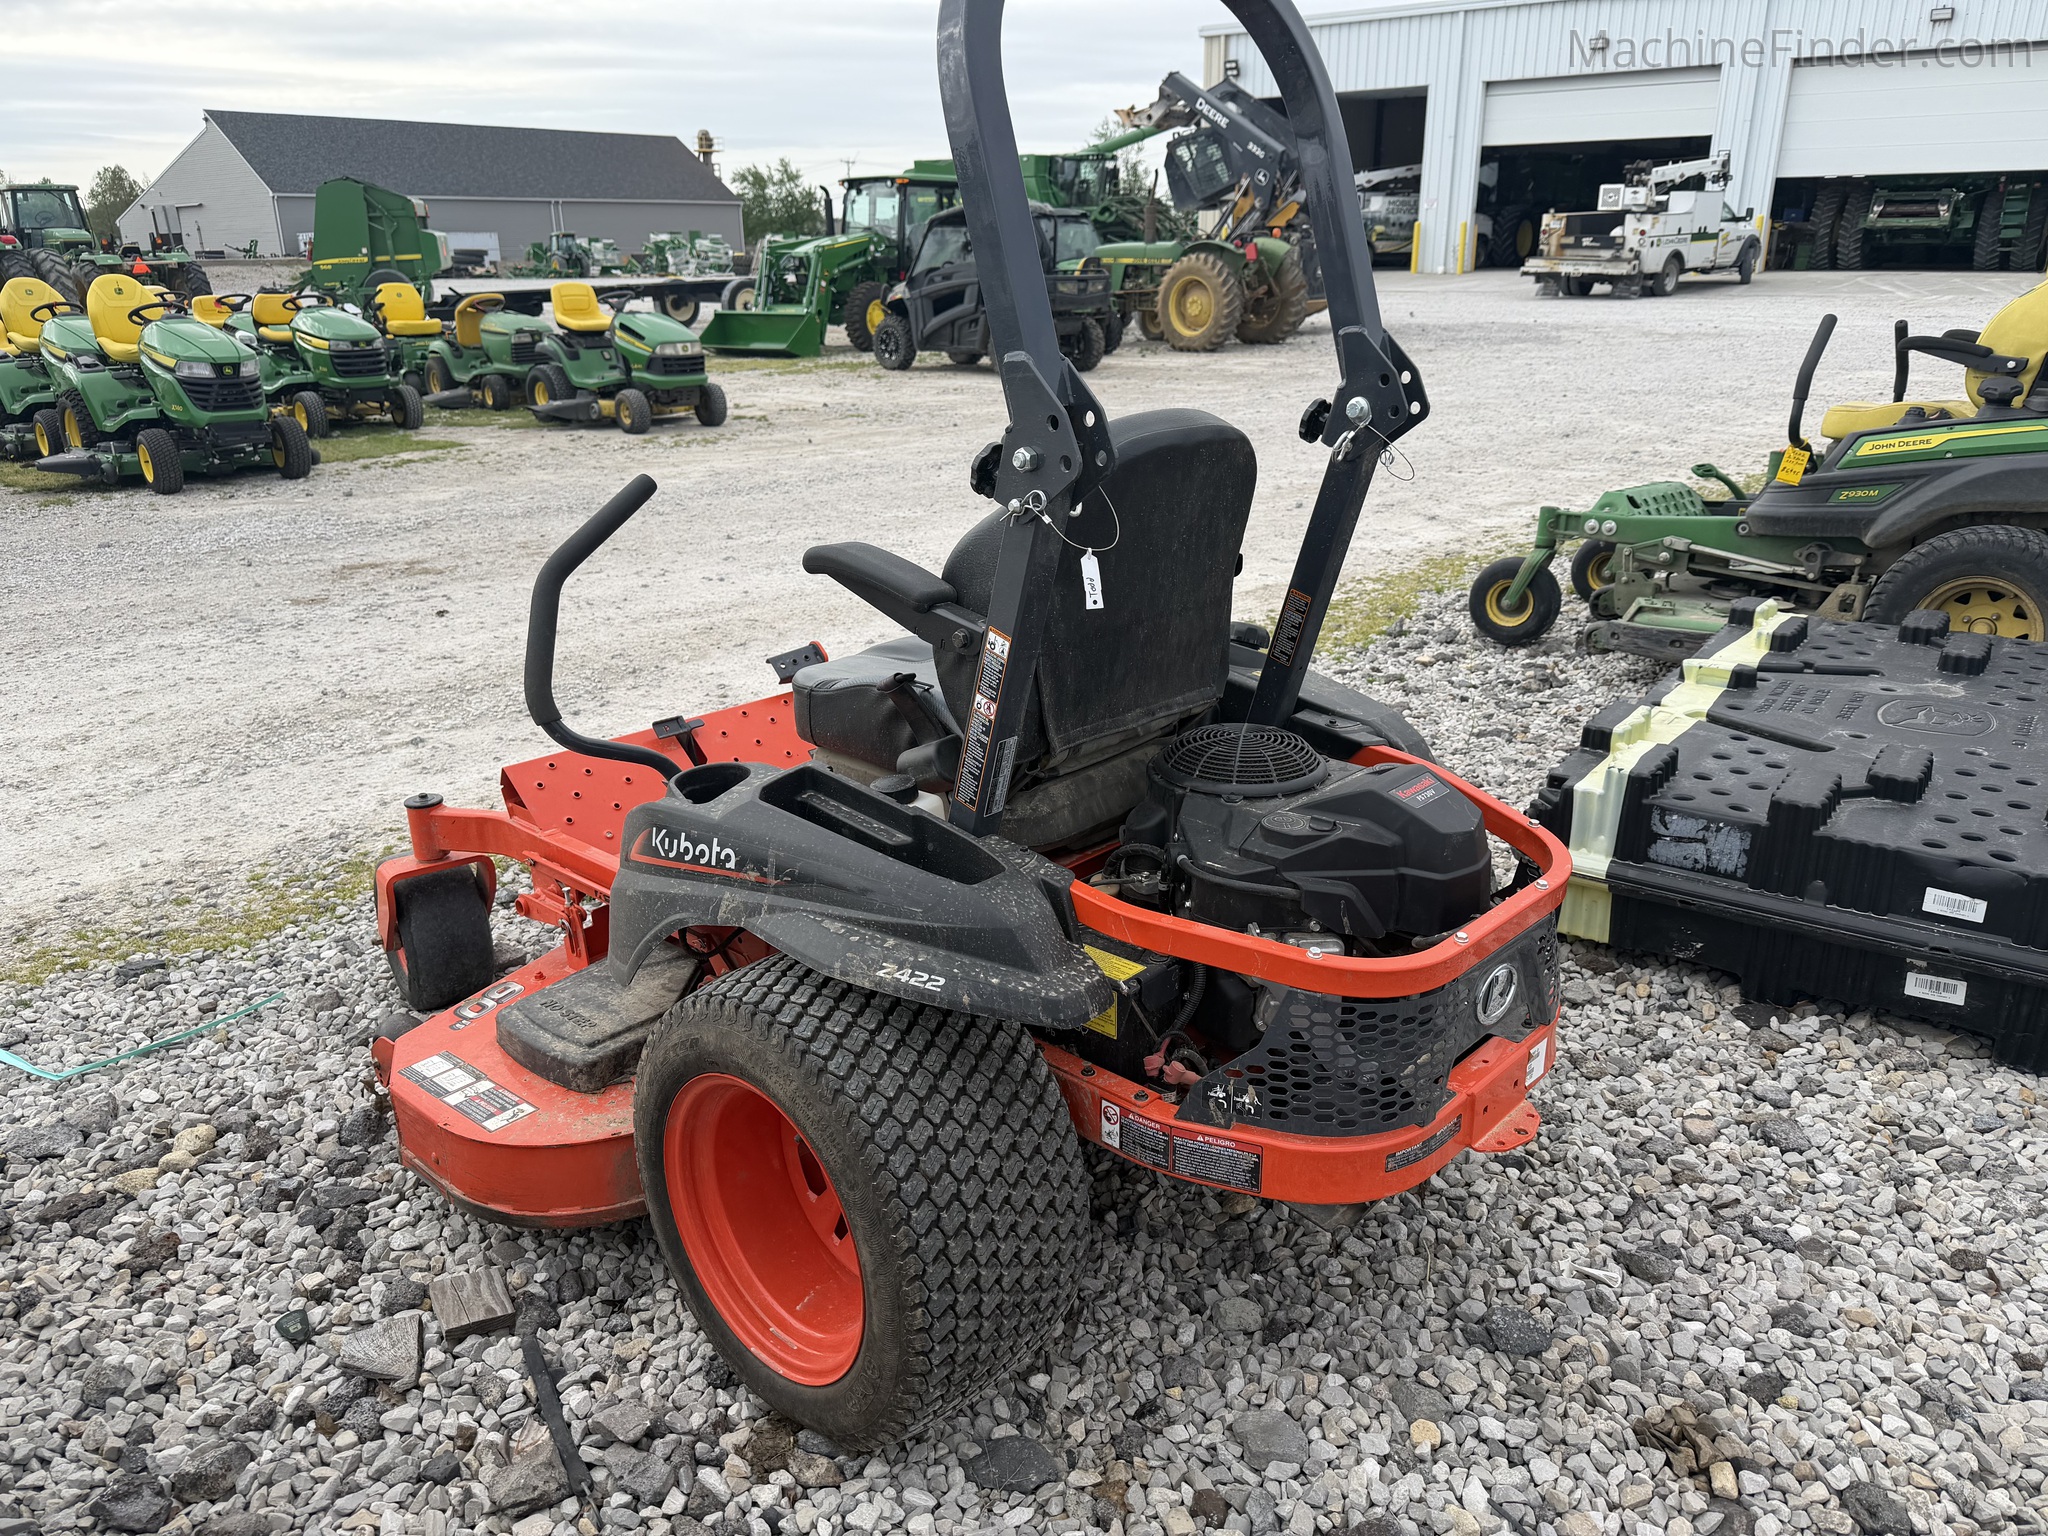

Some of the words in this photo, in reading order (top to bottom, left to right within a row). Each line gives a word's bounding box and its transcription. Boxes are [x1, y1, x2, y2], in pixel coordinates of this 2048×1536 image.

[1195, 97, 1230, 129] DEERE
[1868, 442, 1896, 451] JOHN
[1897, 438, 1933, 448] DEERE
[1839, 489, 1880, 500] Z930M
[1085, 577, 1098, 598] Todd
[1395, 776, 1435, 799] Kawasaki
[652, 826, 736, 870] Kubota
[875, 962, 946, 992] Z422
[540, 1000, 564, 1012] NO
[560, 1009, 598, 1029] STEP
[1045, 1026, 1056, 1037] Pb
[1134, 1114, 1161, 1130] DANGER
[1204, 1136, 1236, 1148] PELIGRO
